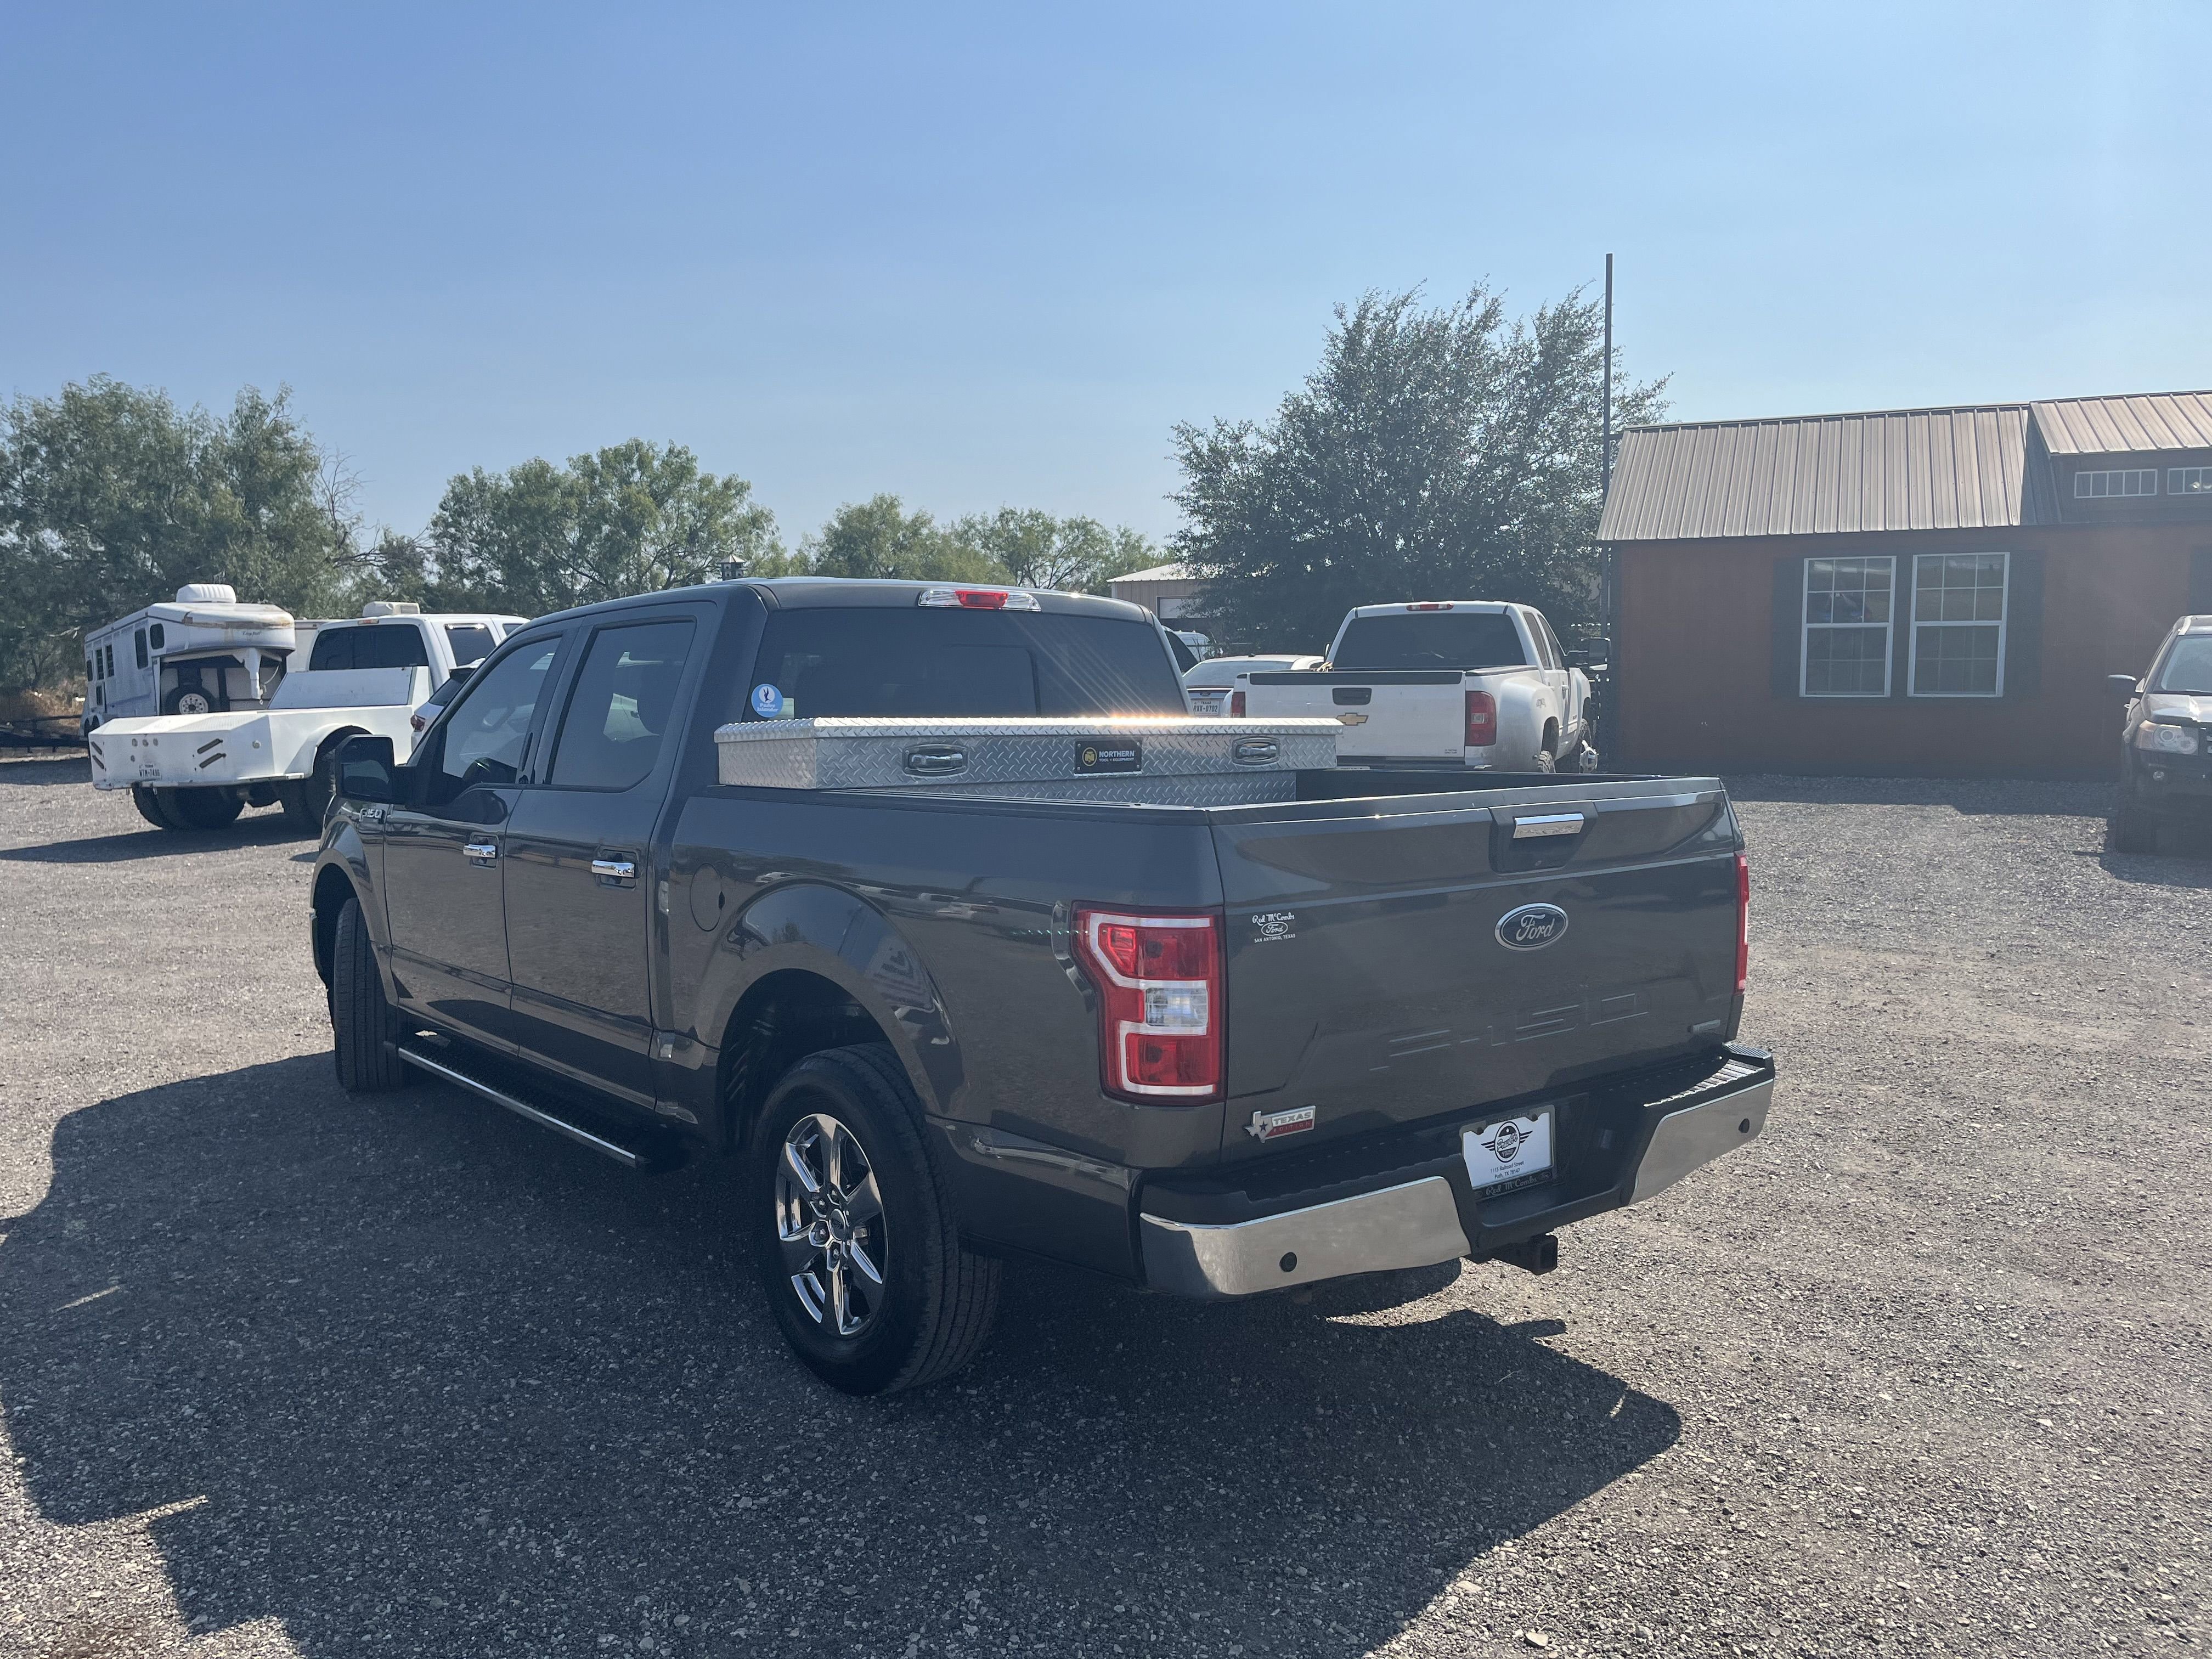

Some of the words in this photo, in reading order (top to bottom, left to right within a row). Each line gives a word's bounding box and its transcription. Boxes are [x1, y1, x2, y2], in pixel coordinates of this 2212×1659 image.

[1252, 915, 1265, 926] Red
[1266, 912, 1295, 922] McCombs
[1266, 924, 1283, 933] Ford
[1516, 914, 1555, 941] Ford
[1273, 1111, 1311, 1125] TEXAS
[1486, 1184, 1502, 1196] Red
